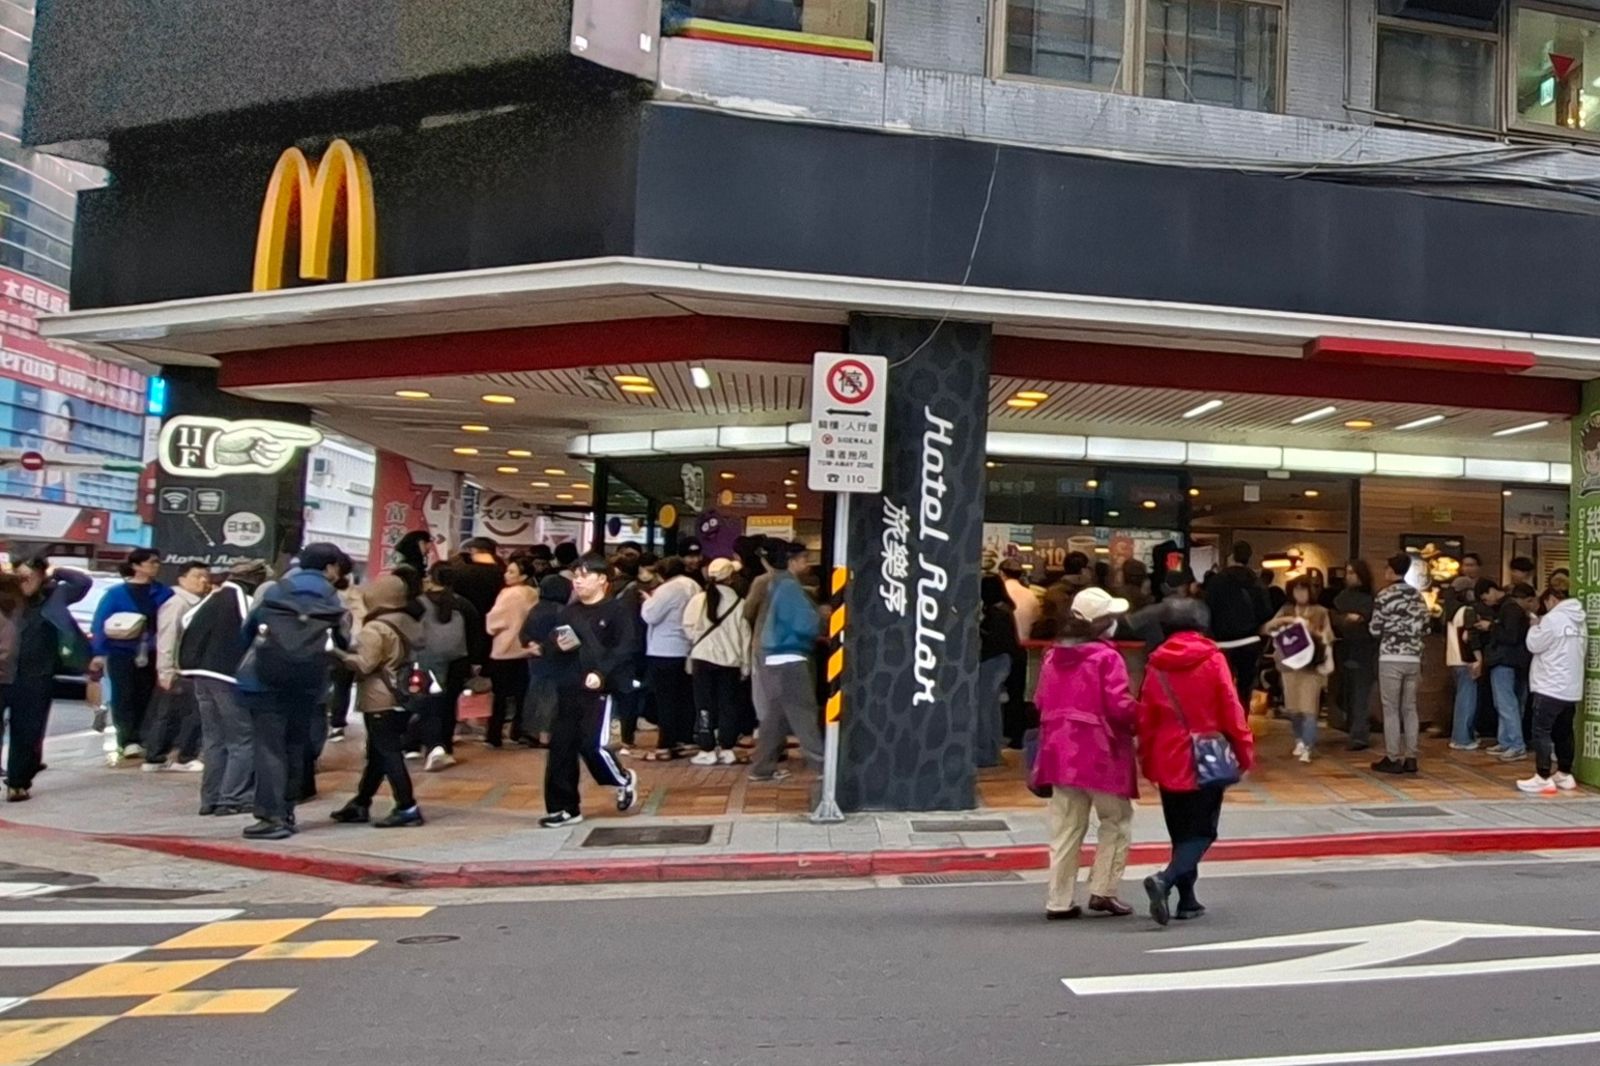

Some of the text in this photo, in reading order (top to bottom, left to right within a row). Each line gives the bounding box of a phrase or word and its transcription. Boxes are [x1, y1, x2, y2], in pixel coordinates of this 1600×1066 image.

[179, 448, 201, 467] F
[846, 474, 865, 483] 110
[911, 405, 954, 706] Hotel Relax
